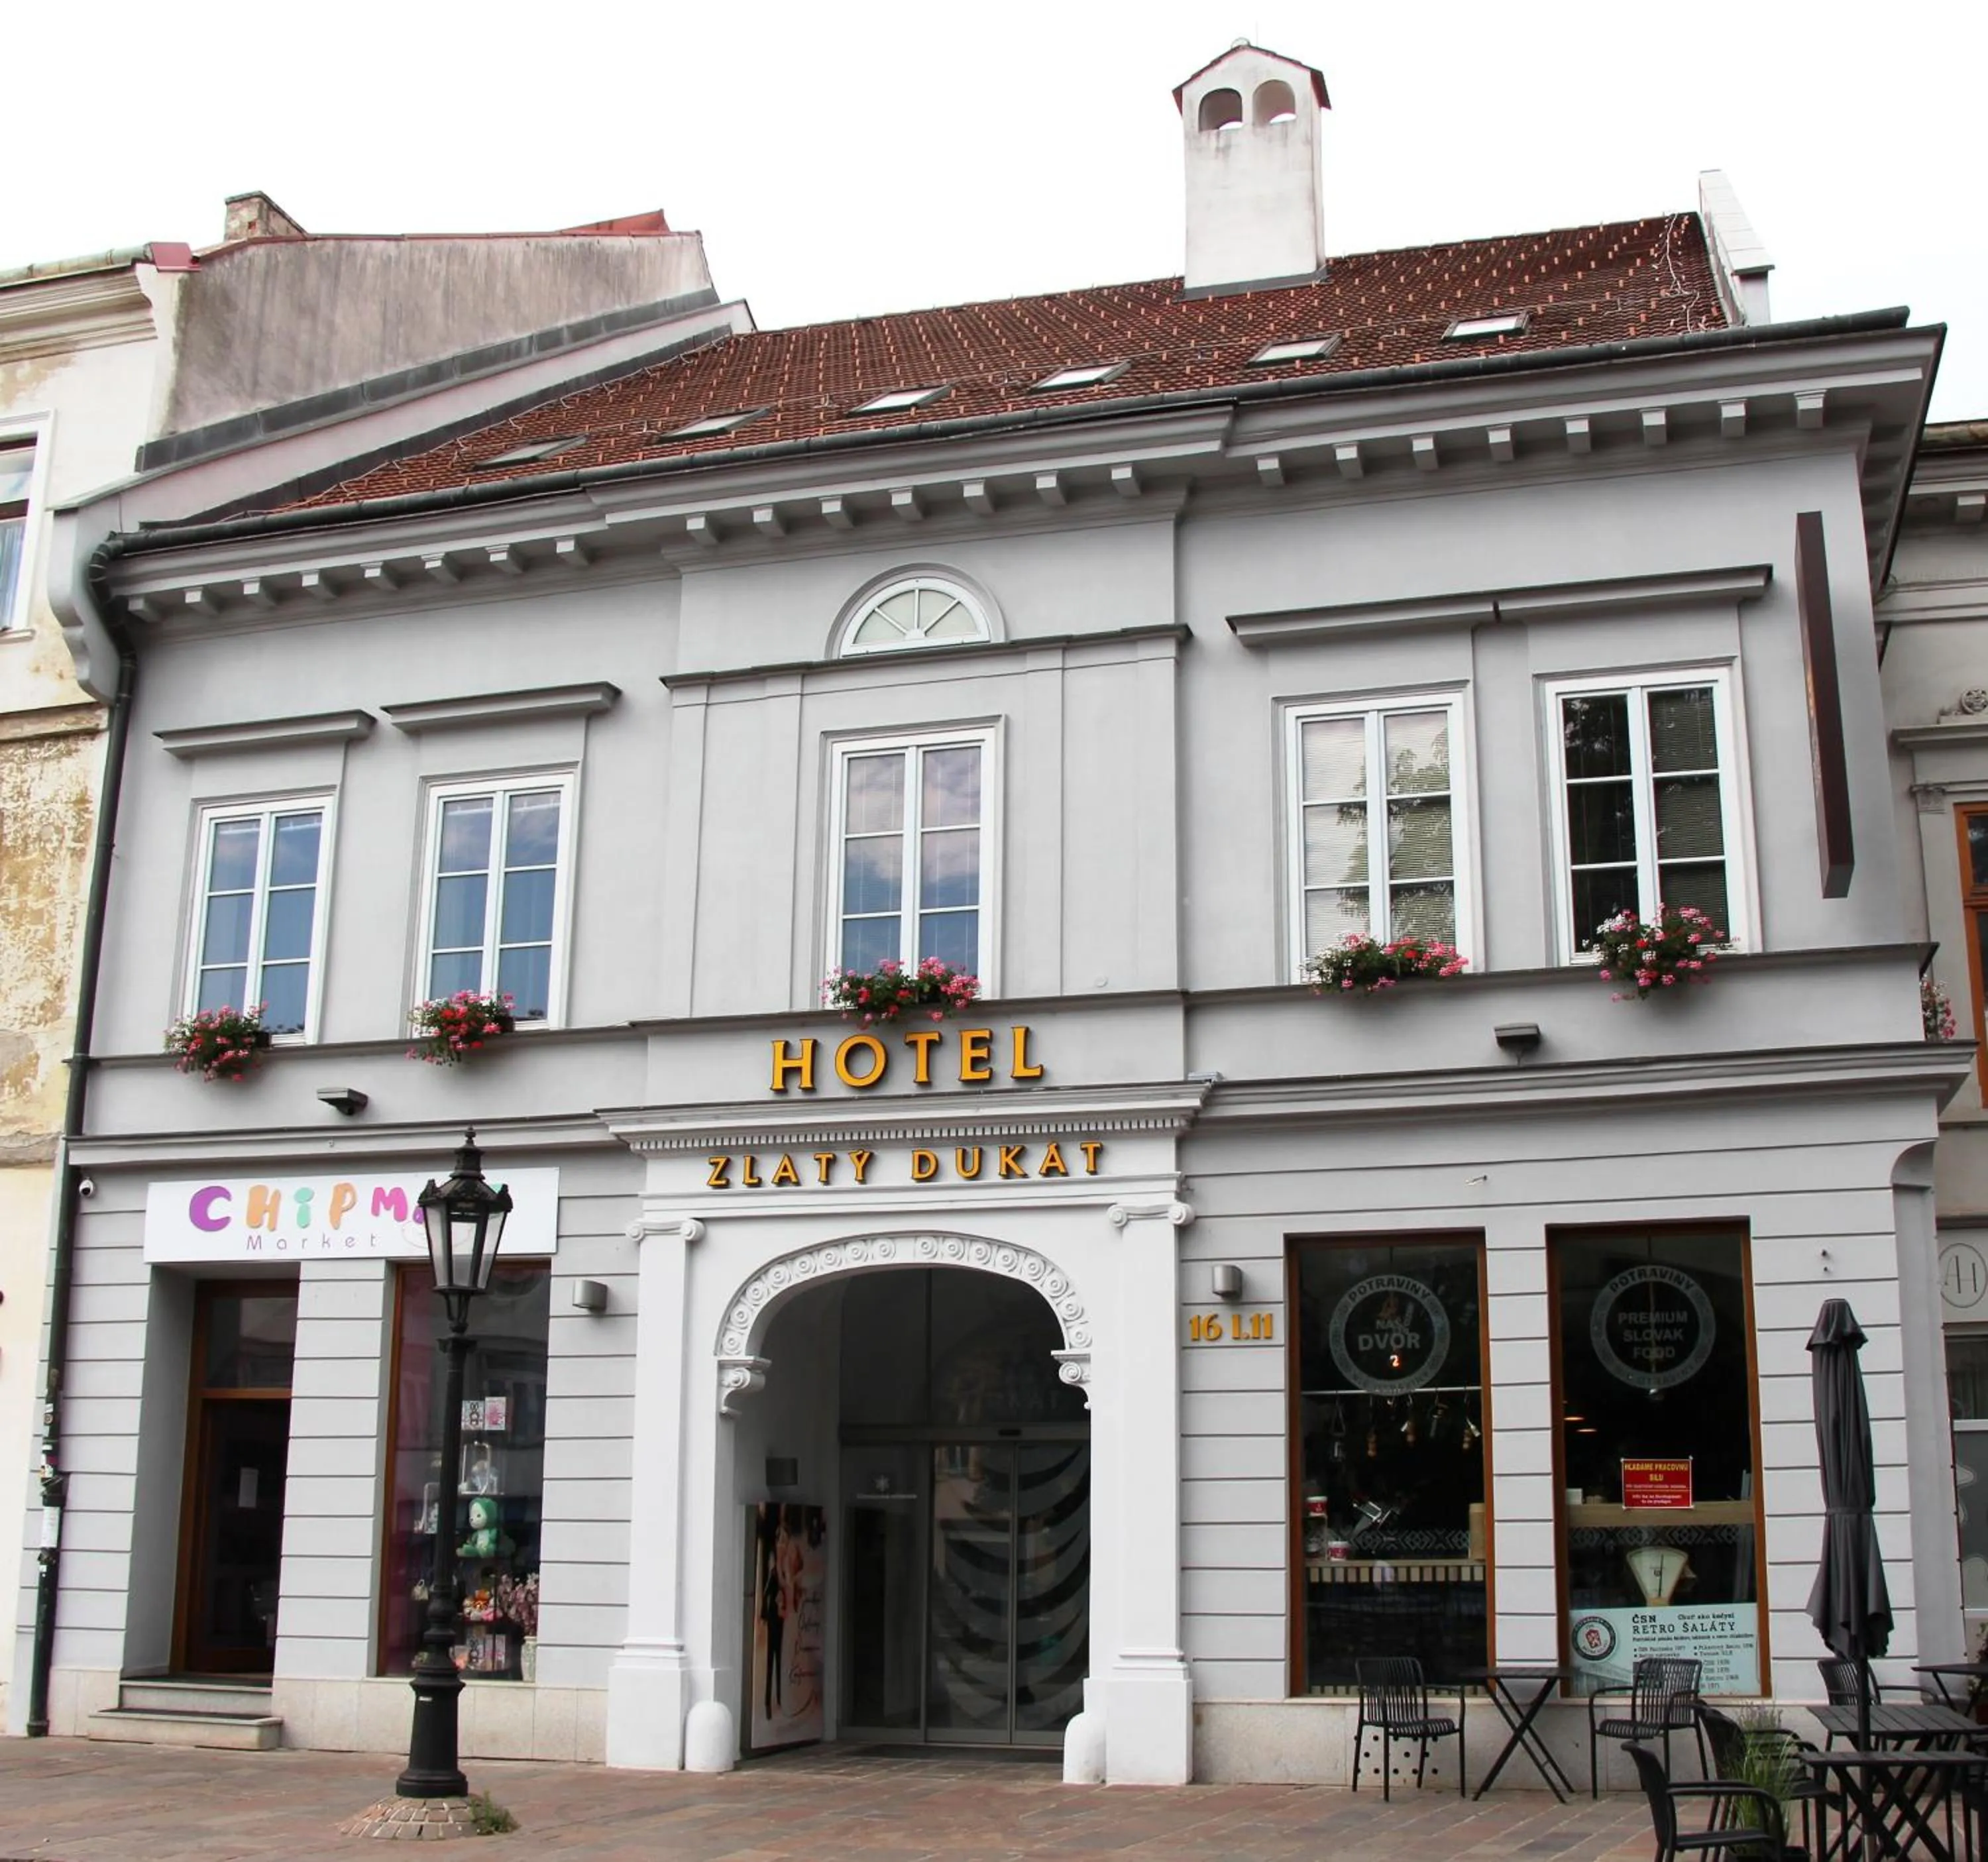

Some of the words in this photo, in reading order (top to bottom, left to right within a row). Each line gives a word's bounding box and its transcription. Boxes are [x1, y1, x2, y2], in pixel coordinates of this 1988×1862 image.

[769, 1025, 1044, 1091] HOTEL
[247, 1233, 378, 1251] Market
[1348, 1277, 1431, 1303] POTRAVINY
[1609, 1268, 1694, 1293] POTRAVINY
[1189, 1313, 1223, 1341] 16
[1618, 1311, 1688, 1325] PREMIUM
[1358, 1332, 1421, 1352] DVOR
[1622, 1328, 1684, 1342] SLOVAK
[1633, 1346, 1676, 1359] FOOD
[1632, 1623, 1675, 1635] RETRO
[1682, 1621, 1736, 1633] ŠALÁTY
